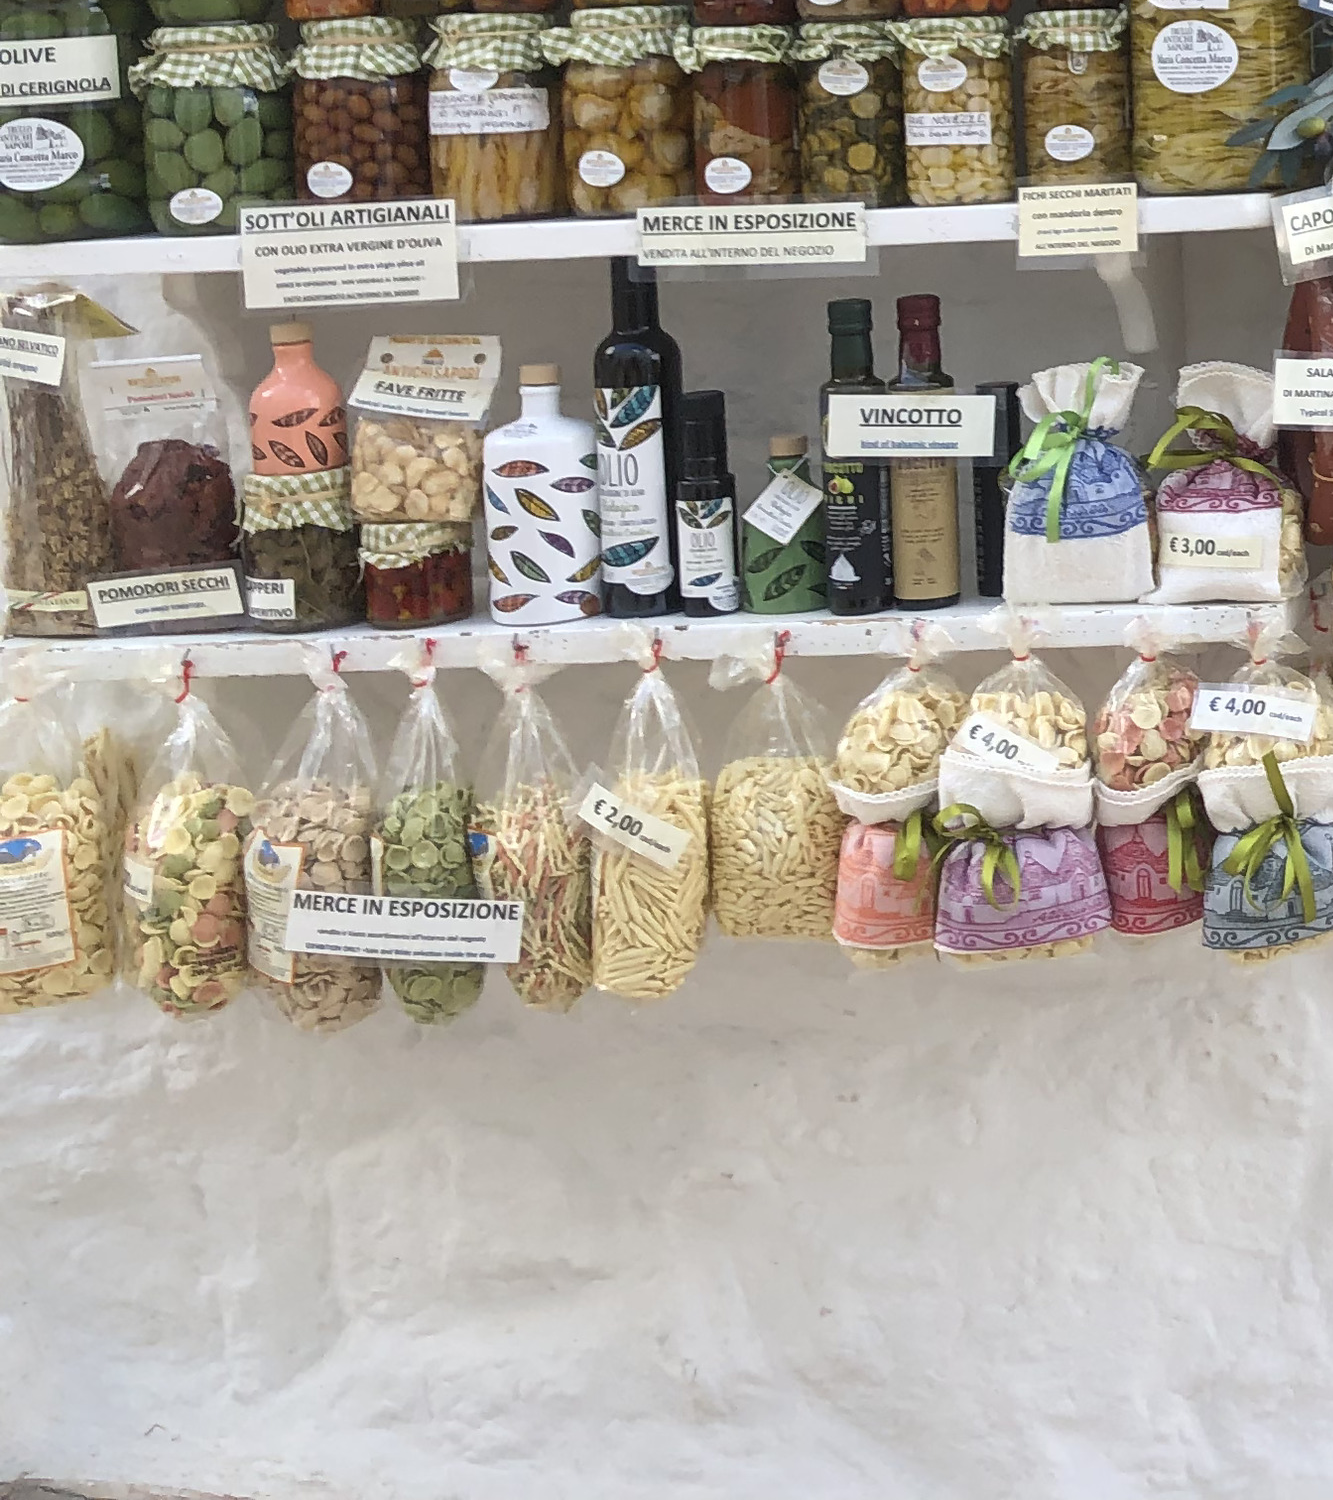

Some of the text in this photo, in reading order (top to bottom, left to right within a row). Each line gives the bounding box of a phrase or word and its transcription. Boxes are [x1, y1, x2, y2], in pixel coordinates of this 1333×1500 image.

[0, 47, 56, 64] OLIVE
[1, 78, 111, 95] DI CERIGNOLA
[1023, 187, 1132, 200] FICHI SECCHI MARITATI
[245, 204, 449, 230] SOTT'OLI ARTIGIANALI
[643, 212, 856, 232] MERCE IN ESPOSIZIONE
[255, 239, 393, 257] CON OLIO EXTRA VERGINE
[643, 245, 835, 259] VENDITA ALL'INTERNO DEL NEGOZIO
[1304, 244, 1314, 256] Di
[375, 381, 466, 402] FAVE FRITTE
[1283, 390, 1292, 399] DI
[860, 408, 963, 424] VINCOTTO
[1300, 408, 1327, 419] Typical
[1180, 537, 1216, 557] 3,00
[98, 575, 229, 602] POMODORI SECCHI
[1209, 697, 1266, 716] € 4,00
[969, 724, 1019, 761] € 4,00
[593, 799, 643, 837] € 2,00
[294, 893, 519, 921] MERCE IN ESPOSIZIONE
